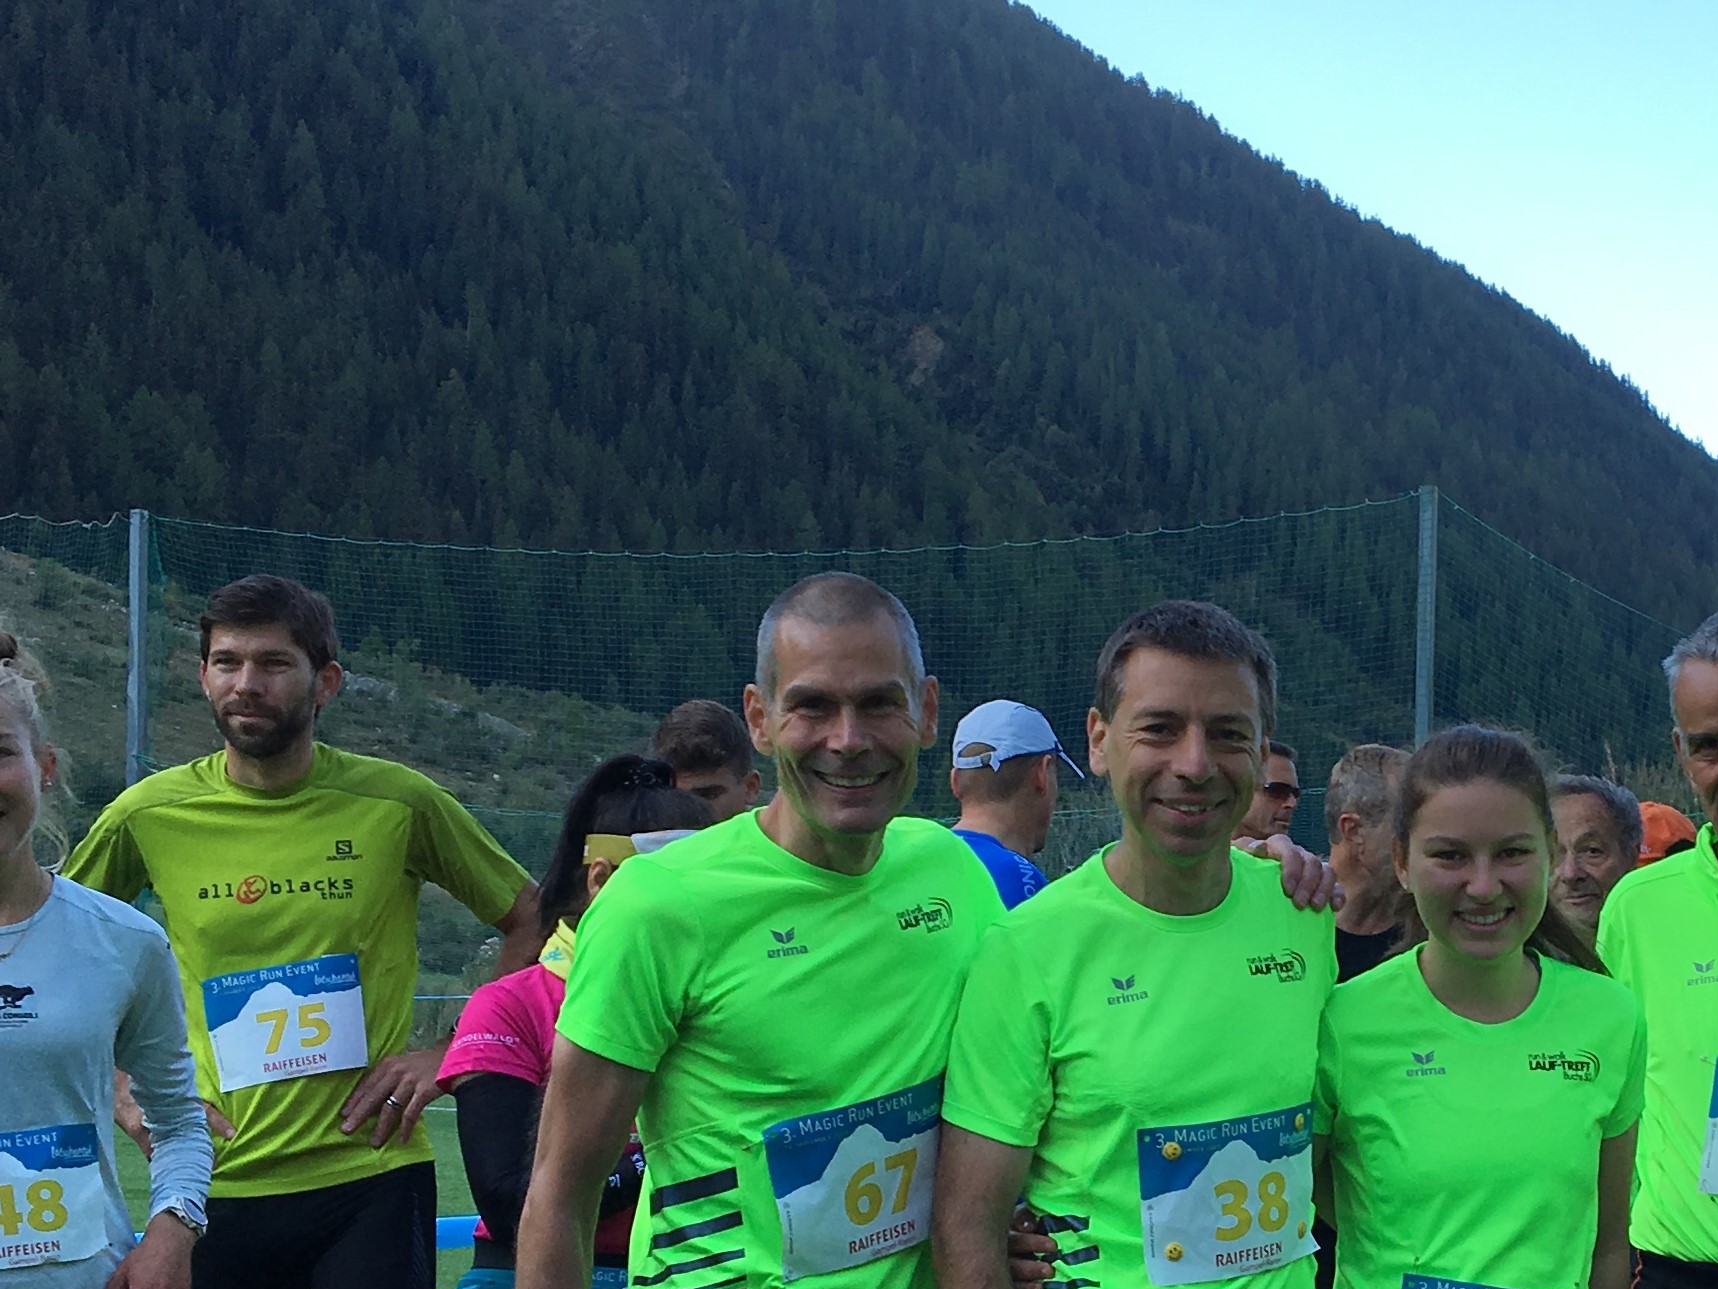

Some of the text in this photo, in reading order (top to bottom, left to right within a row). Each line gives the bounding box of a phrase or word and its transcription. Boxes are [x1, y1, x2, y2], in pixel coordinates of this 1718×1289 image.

[198, 877, 354, 900] all blacks
[321, 890, 353, 900] thun
[767, 945, 809, 959] erima
[222, 973, 256, 988] MAGIC
[259, 968, 283, 982] RUN
[285, 962, 320, 977] EVENT
[1107, 989, 1149, 1006] erima
[255, 1002, 331, 1055] 75
[263, 1053, 327, 1073] RAIFFEISEN
[1406, 1066, 1447, 1078] erima
[1529, 1060, 1591, 1072] LAUF-TREFF
[799, 1114, 845, 1136] MAGIC
[848, 1105, 875, 1124] RUN
[877, 1093, 914, 1115] EVENT
[15, 1132, 57, 1147] EVENT
[1174, 1127, 1218, 1143] MAGIC
[1221, 1122, 1248, 1138] RUN
[1251, 1115, 1286, 1133] EVENT
[845, 1147, 918, 1227] 67
[1214, 1171, 1289, 1242] 38
[849, 1219, 916, 1255] RAIFFEISEN
[1216, 1241, 1283, 1268] RAIFFEISEN
